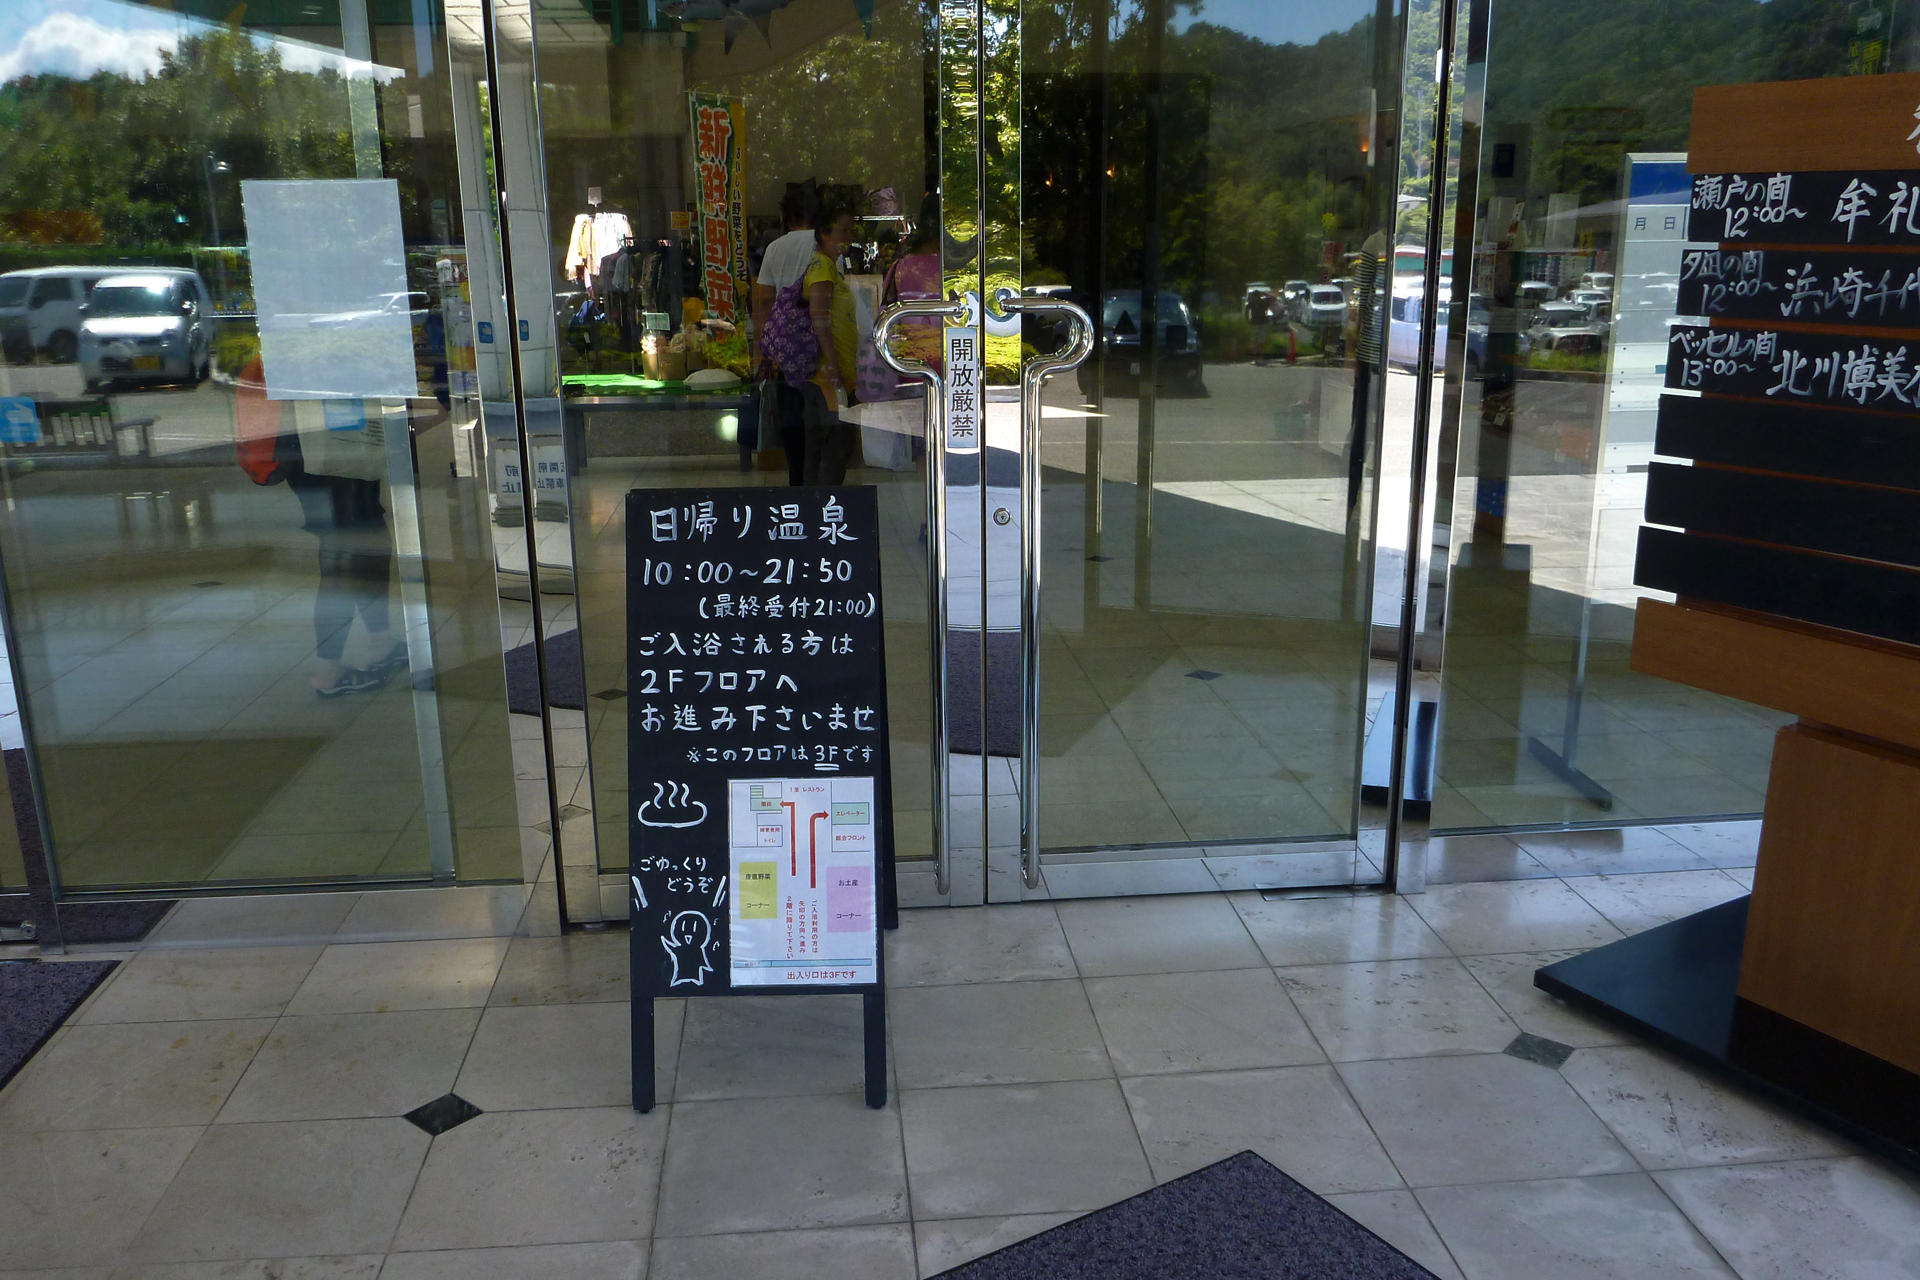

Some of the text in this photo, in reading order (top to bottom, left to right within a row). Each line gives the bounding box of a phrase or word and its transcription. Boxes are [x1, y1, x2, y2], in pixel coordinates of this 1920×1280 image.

[1692, 172, 1793, 211] 瀬戸の間
[697, 105, 736, 323] 新鮮野菜
[731, 146, 748, 283] おいしい野菜をどうぞ
[1633, 216, 1676, 231] 月 日
[1681, 250, 1764, 281] 夕凪の間
[1670, 330, 1778, 364] ベッセルの間
[951, 338, 974, 438] 開放厳禁
[650, 495, 859, 546] 日帰り温泉
[639, 629, 854, 657] ご入浴される方は
[640, 669, 798, 694] 2Fフロアへ
[641, 702, 876, 733] お進み下さいませ
[640, 856, 708, 872] ごゆっくり
[666, 876, 714, 894] どうぞ
[838, 879, 858, 887] お土産
[786, 970, 857, 980] 出入り口は3Fです
